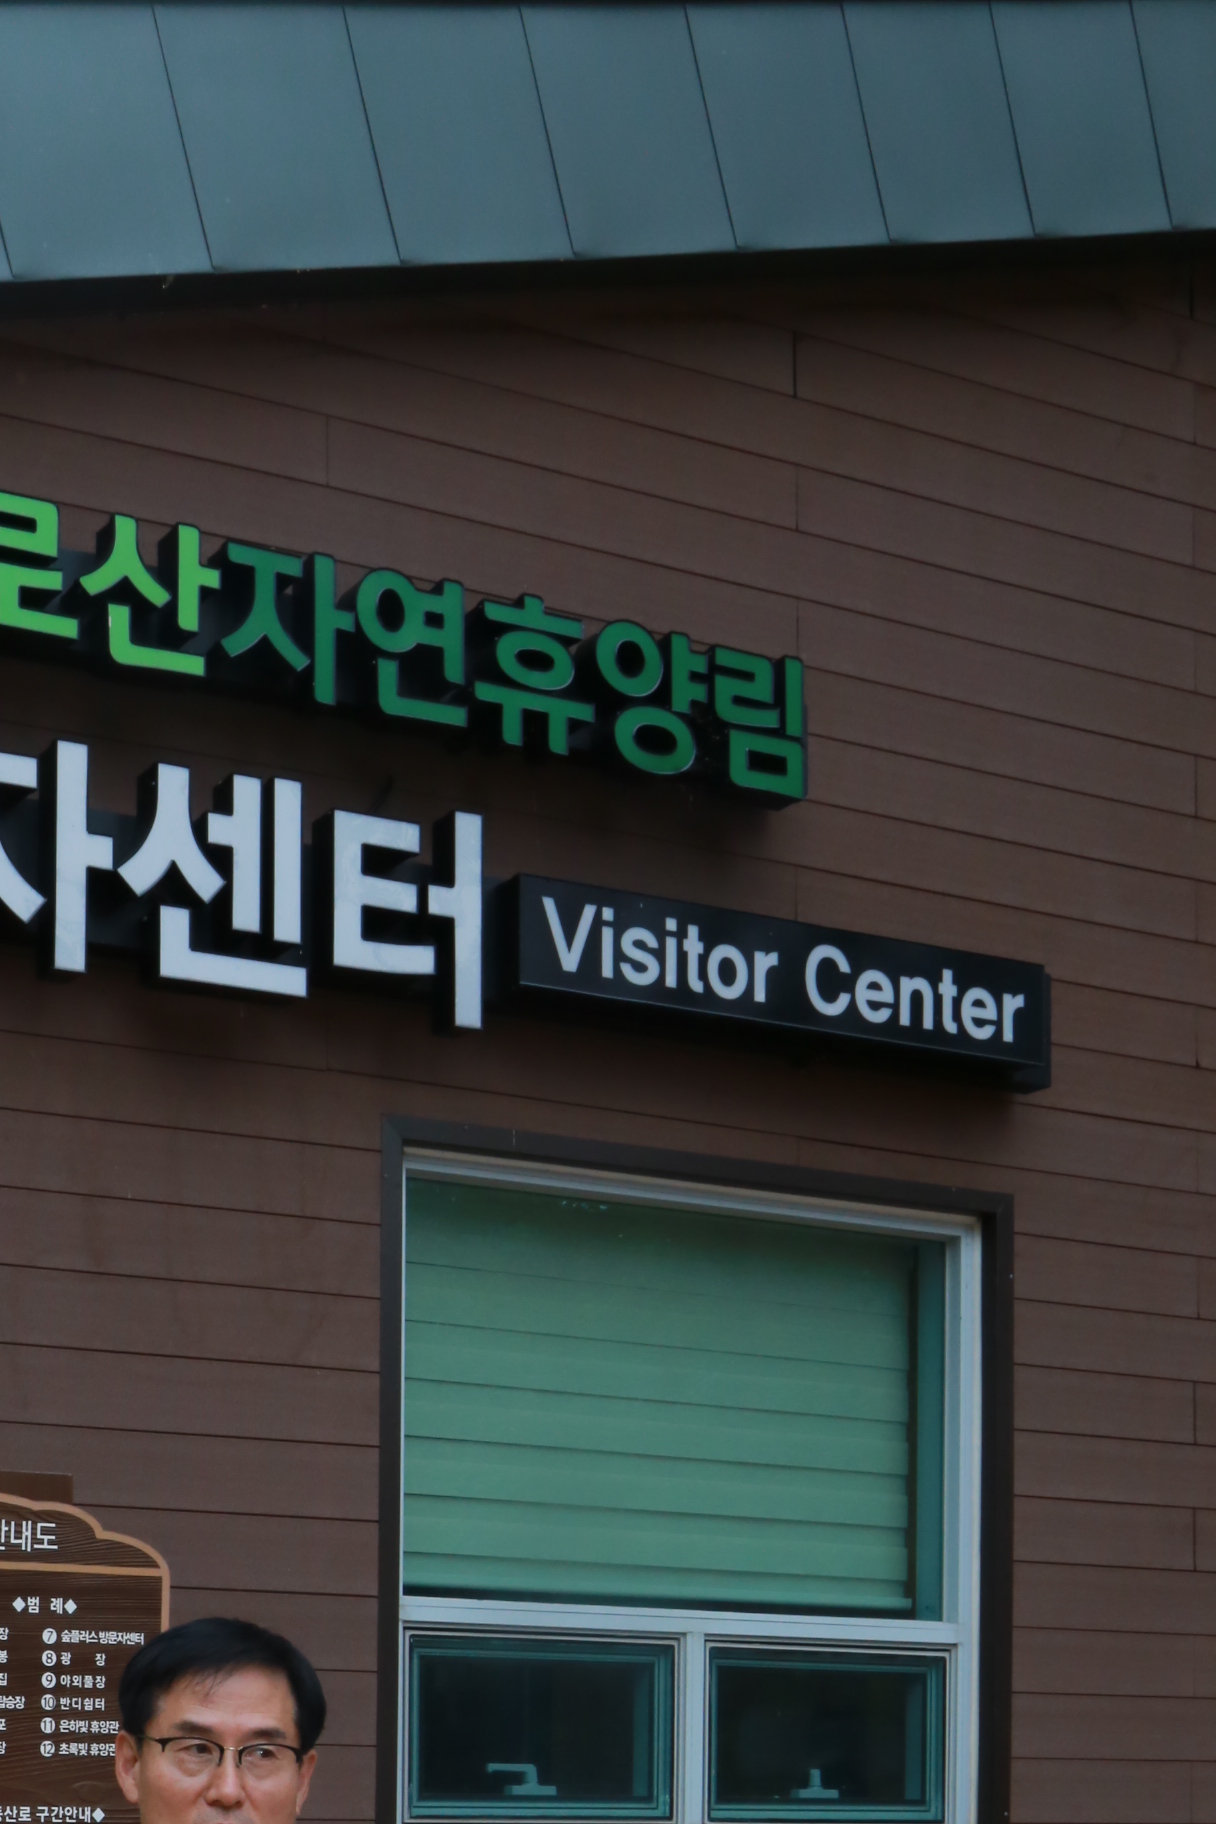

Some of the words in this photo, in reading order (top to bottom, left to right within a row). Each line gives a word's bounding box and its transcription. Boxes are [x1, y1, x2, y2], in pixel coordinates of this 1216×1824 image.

[541, 895, 780, 1003] Visitor
[804, 943, 1026, 1045] Center
[59, 1719, 89, 1734] 은하빛
[90, 1720, 120, 1734] 휴양관
[36, 1806, 91, 1824] 구간안내
